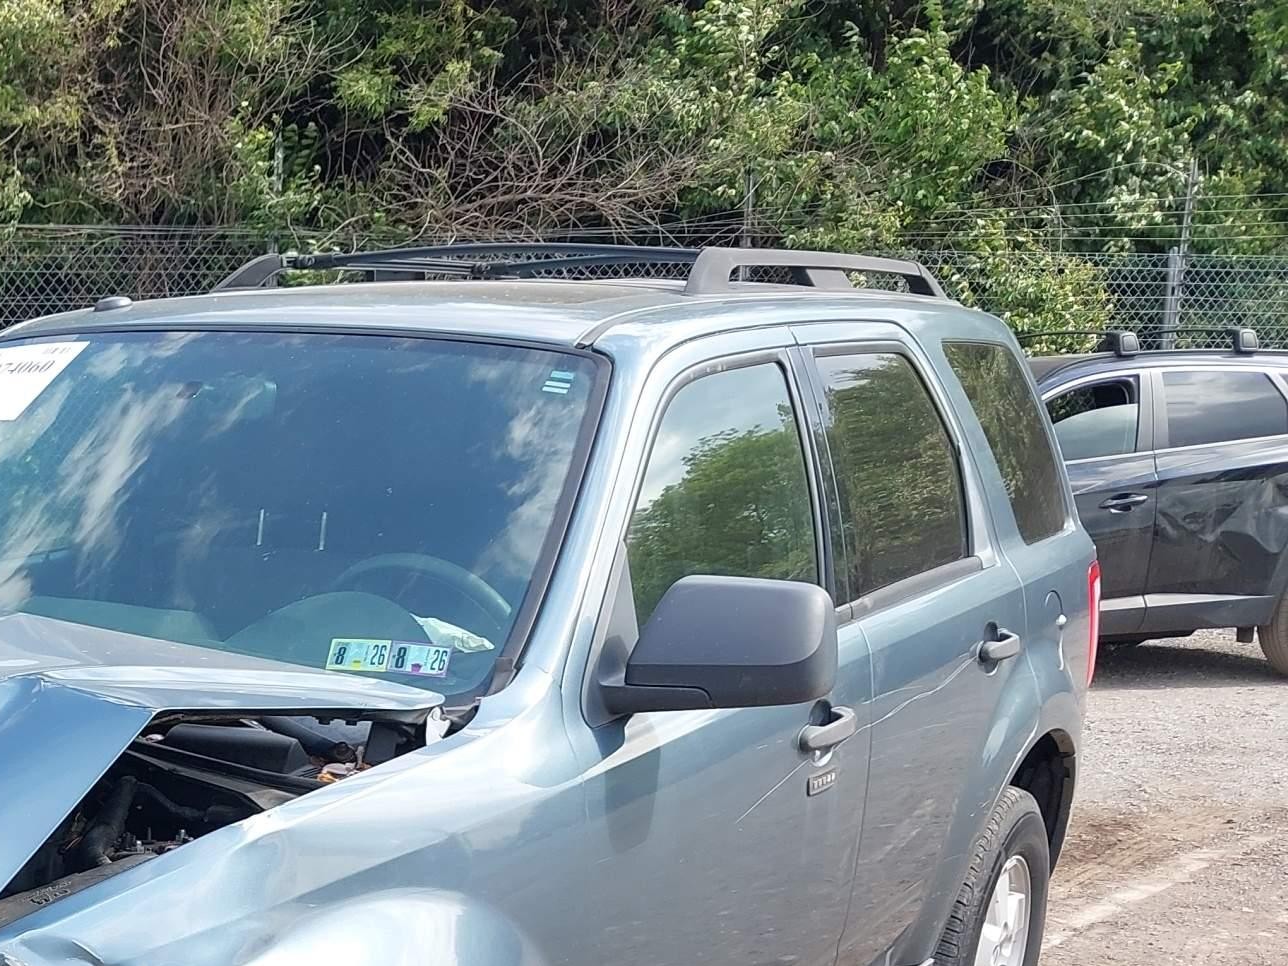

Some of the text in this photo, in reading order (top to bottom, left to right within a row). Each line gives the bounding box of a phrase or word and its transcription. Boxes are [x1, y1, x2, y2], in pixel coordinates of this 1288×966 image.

[335, 646, 347, 665] 8
[369, 644, 386, 667] 26
[395, 646, 407, 669] 8
[430, 649, 448, 672] 26
